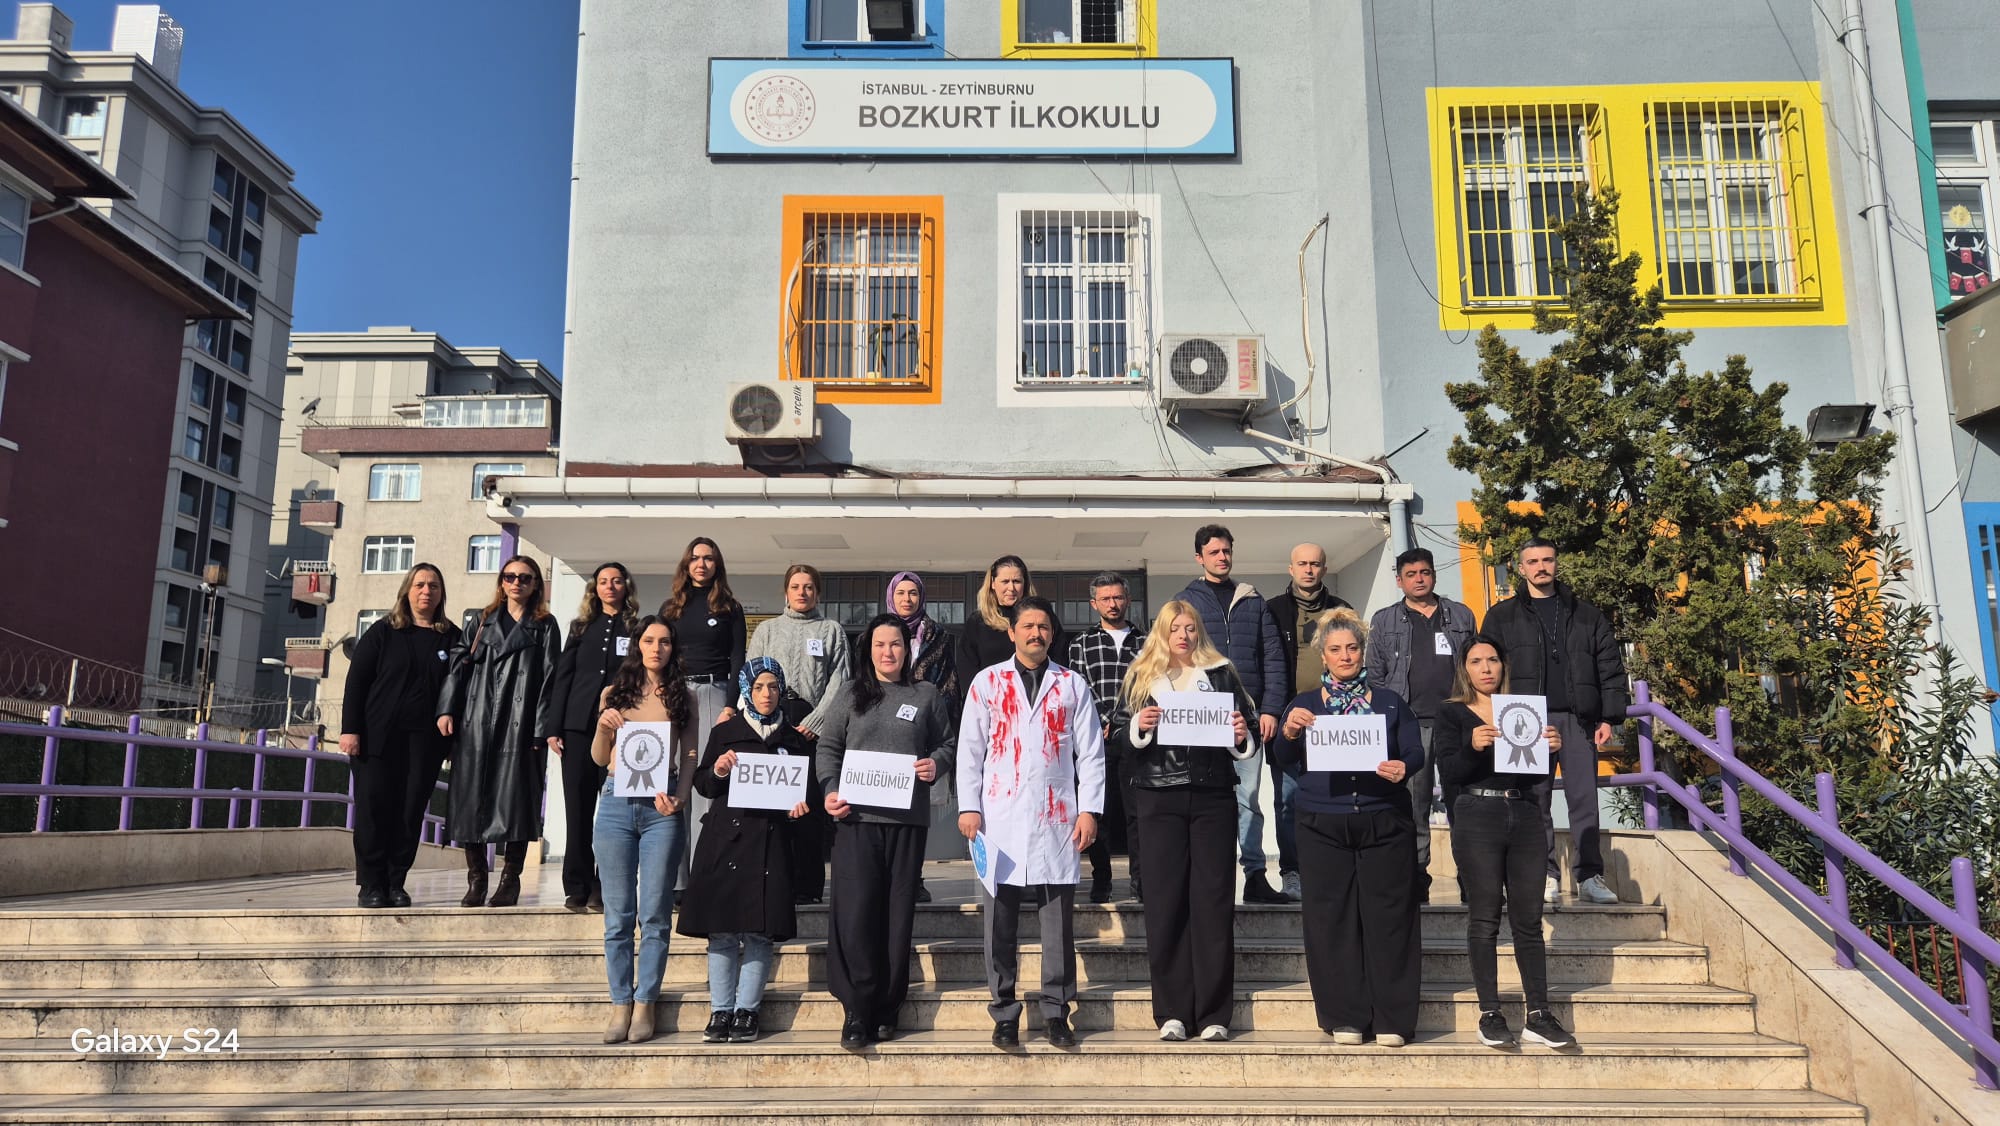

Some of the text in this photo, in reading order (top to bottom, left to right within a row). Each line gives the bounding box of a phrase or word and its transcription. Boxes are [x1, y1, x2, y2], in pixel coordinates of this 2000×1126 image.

[862, 81, 928, 95] İSTANBUL
[939, 82, 1034, 96] ZEYTİNBURNU
[859, 100, 1160, 129] BOZKURT İLKOKULU
[792, 385, 803, 416] arçelik
[1162, 706, 1230, 725] KEFENİMİZ
[1311, 729, 1381, 746] OLMASIN !
[737, 763, 801, 787] BEYAZ
[845, 769, 910, 790] ÖNLÜĞÜMÜZ
